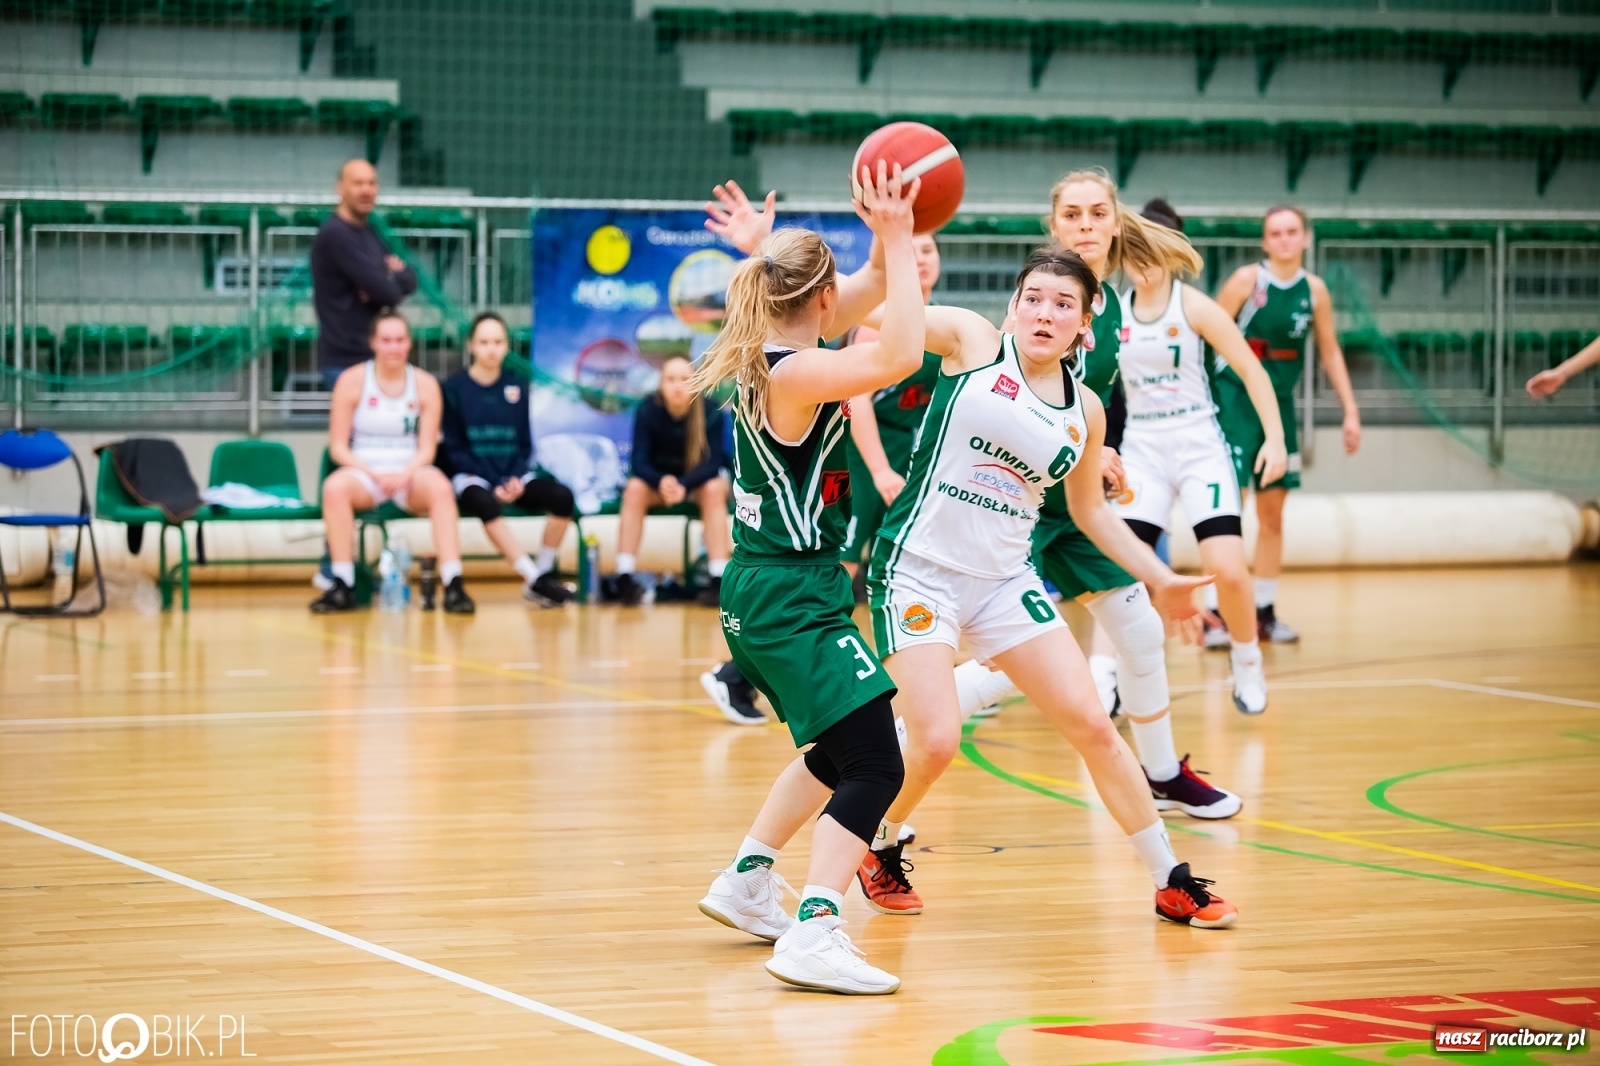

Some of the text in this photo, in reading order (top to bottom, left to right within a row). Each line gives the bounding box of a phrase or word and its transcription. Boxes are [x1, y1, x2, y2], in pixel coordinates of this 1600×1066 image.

[1168, 345, 1181, 368] 7
[969, 436, 1042, 484] OLIMPIA
[1048, 446, 1076, 480] 6
[937, 481, 1018, 517] WODZISŁAW
[1207, 483, 1221, 509] 7
[1020, 589, 1056, 624] 6
[836, 634, 877, 681] 3
